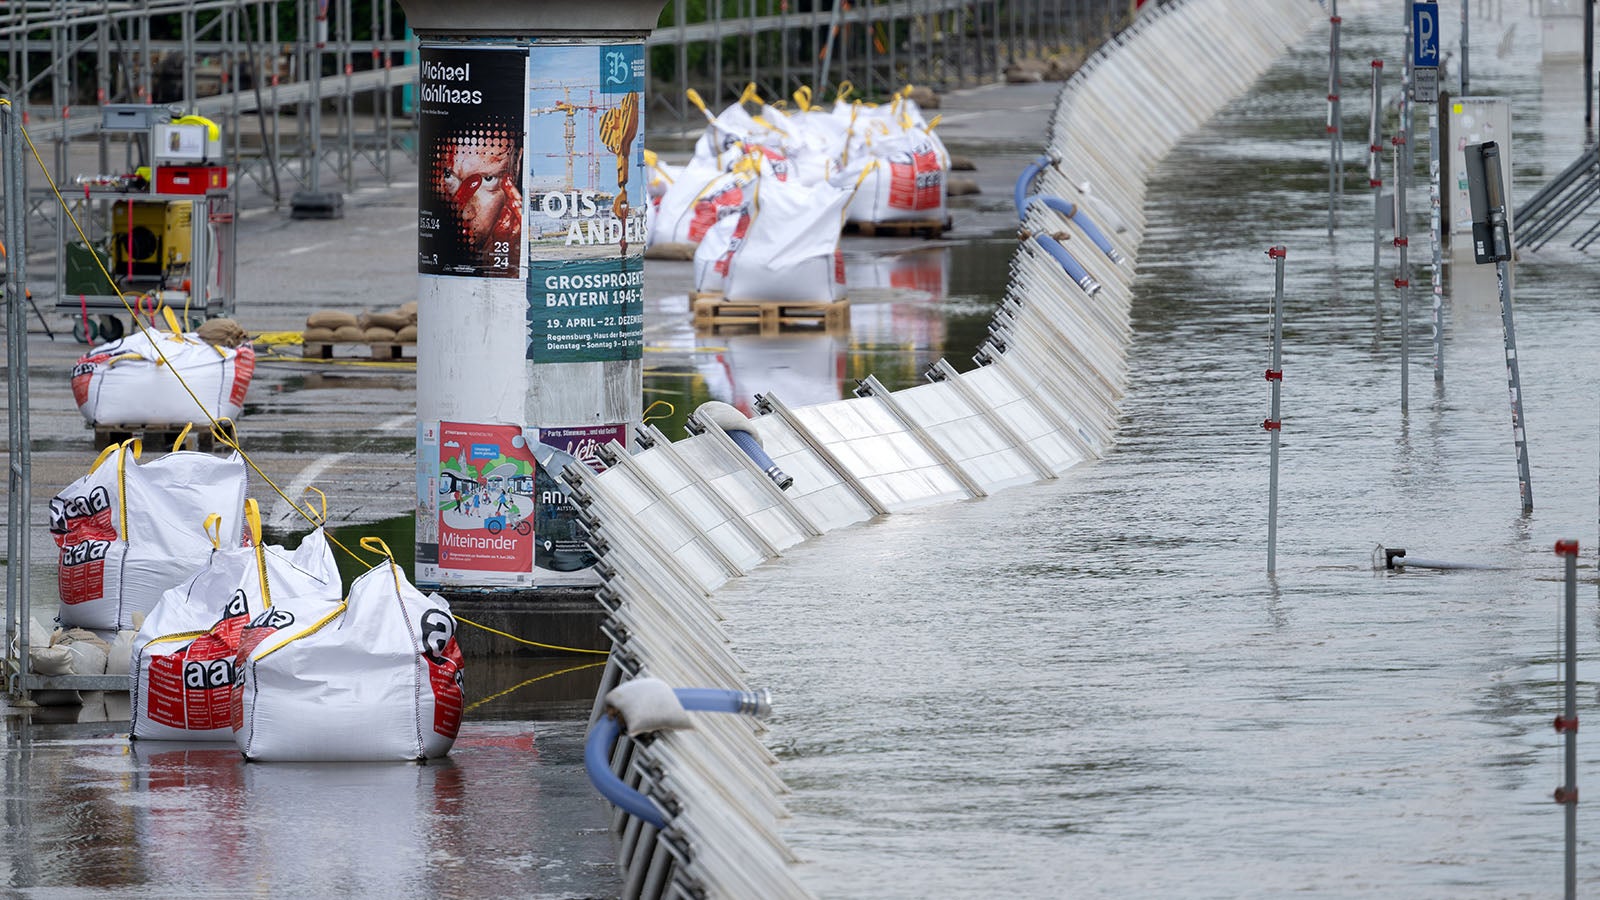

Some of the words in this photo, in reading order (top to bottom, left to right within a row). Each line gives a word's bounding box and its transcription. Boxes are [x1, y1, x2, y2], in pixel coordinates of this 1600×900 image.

[421, 60, 470, 82] Michael
[421, 83, 483, 105] Kohlhaas
[543, 191, 597, 218] OIS
[494, 241, 510, 253] 23
[493, 257, 510, 268] 24
[546, 291, 609, 307] BAYERN
[546, 319, 563, 329] 19.
[566, 318, 596, 328] APRIL
[604, 316, 617, 326] 22.
[547, 332, 593, 342] Regensburg,
[547, 341, 580, 350] Dienstag
[442, 532, 518, 550] Miteinander
